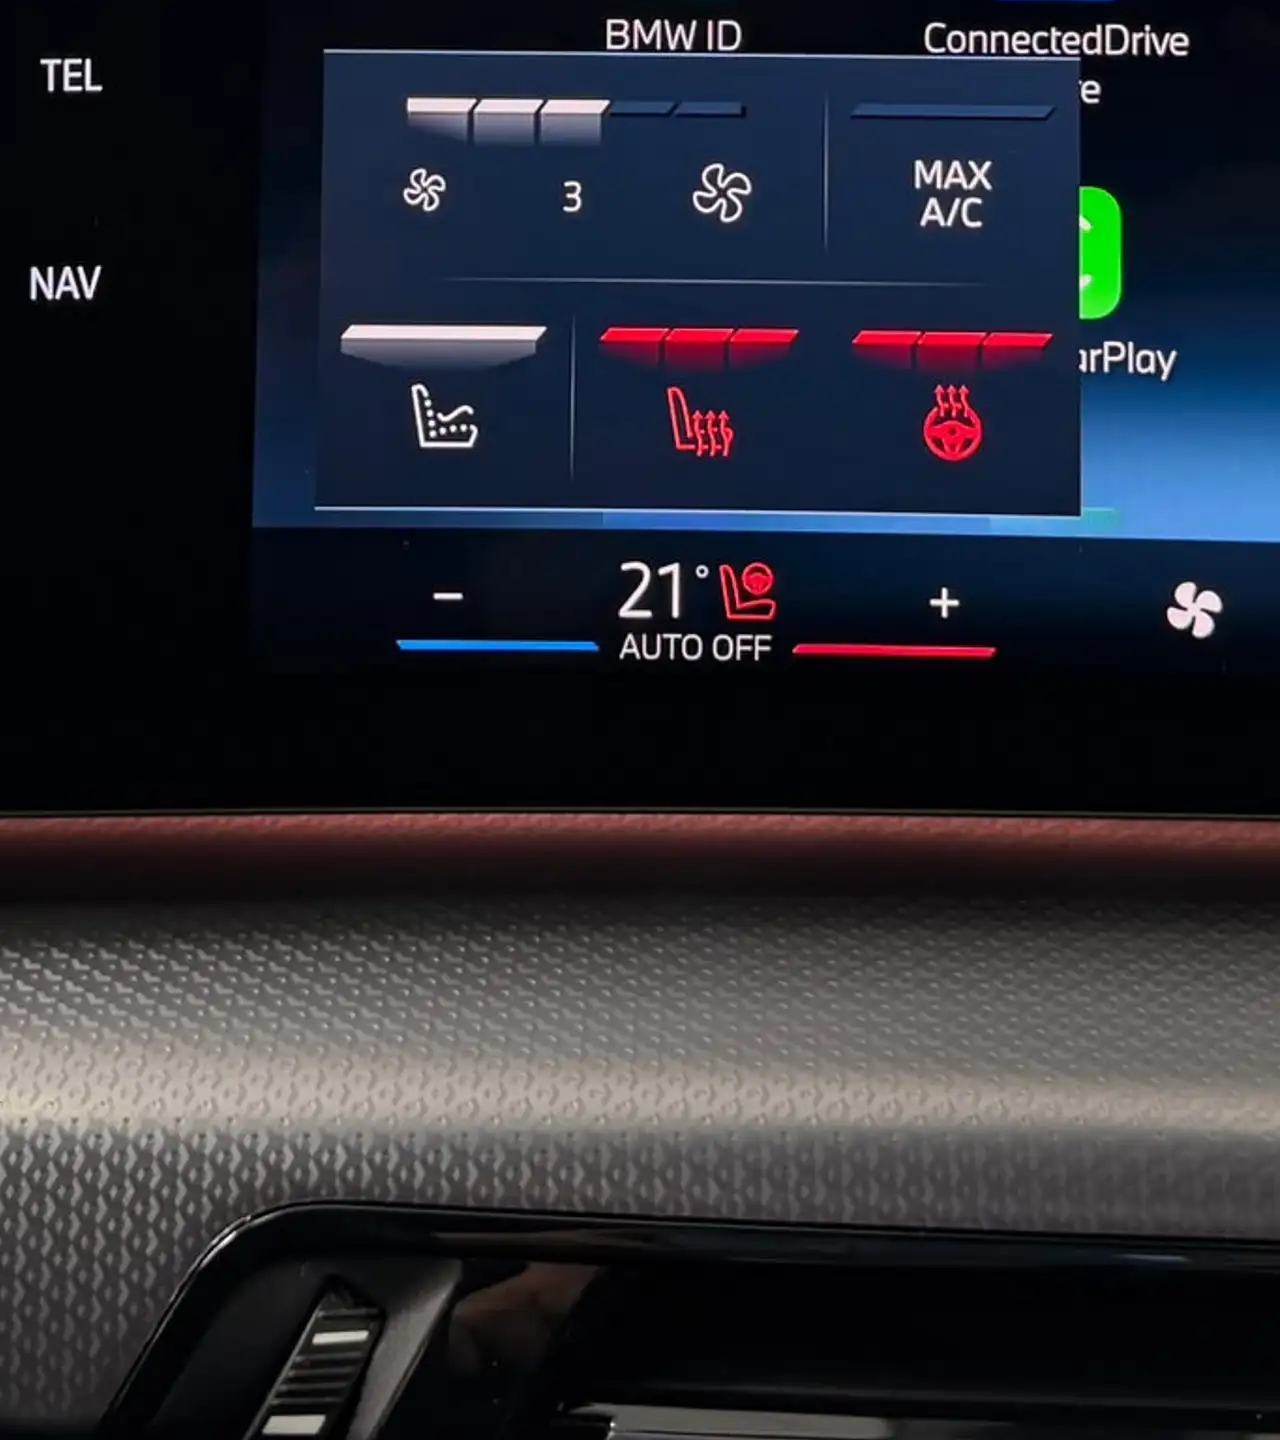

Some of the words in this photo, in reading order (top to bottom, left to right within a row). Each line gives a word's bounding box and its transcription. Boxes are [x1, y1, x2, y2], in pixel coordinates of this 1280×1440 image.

[606, 18, 697, 51] BMW
[707, 19, 742, 51] ID
[923, 21, 1191, 57] ConnectedDrive
[39, 58, 103, 92] TEL
[914, 159, 992, 191] MAX
[563, 180, 582, 213] 3
[919, 196, 983, 228] A/C
[30, 265, 102, 301] NAV
[619, 633, 703, 661] AUTO
[712, 633, 772, 661] OFF
